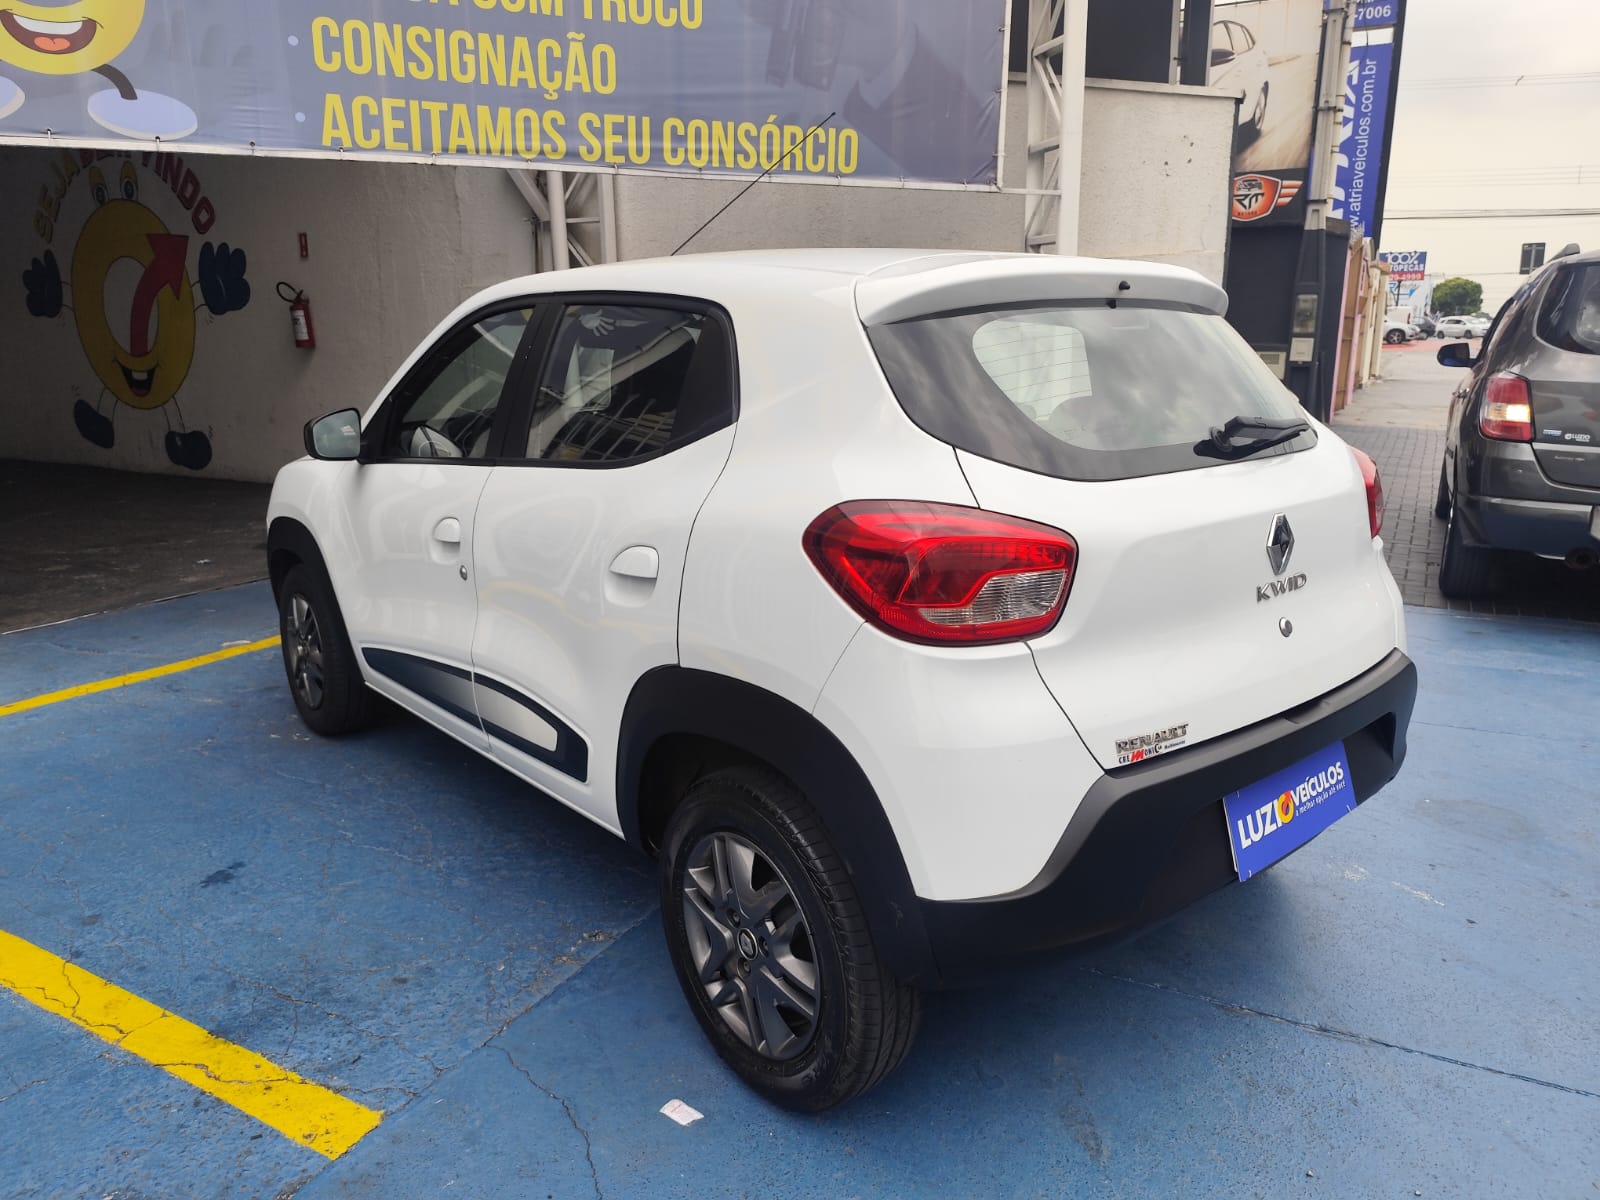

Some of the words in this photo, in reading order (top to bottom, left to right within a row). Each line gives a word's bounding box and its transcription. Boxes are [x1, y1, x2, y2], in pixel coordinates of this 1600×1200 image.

[311, 16, 617, 101] CONSIGNAÇÃO
[321, 92, 567, 161] ACEITAMOS
[577, 110, 651, 165] SEU
[662, 114, 860, 175] CONSÓRCIO
[1348, 58, 1378, 229] w.atriaveiculos.com.br
[1385, 252, 1420, 265] 100%
[1256, 573, 1307, 604] KWID
[1115, 723, 1189, 754] RENAULT
[1237, 789, 1295, 849] LUZIO
[1290, 761, 1344, 806] VEÍCULOS
